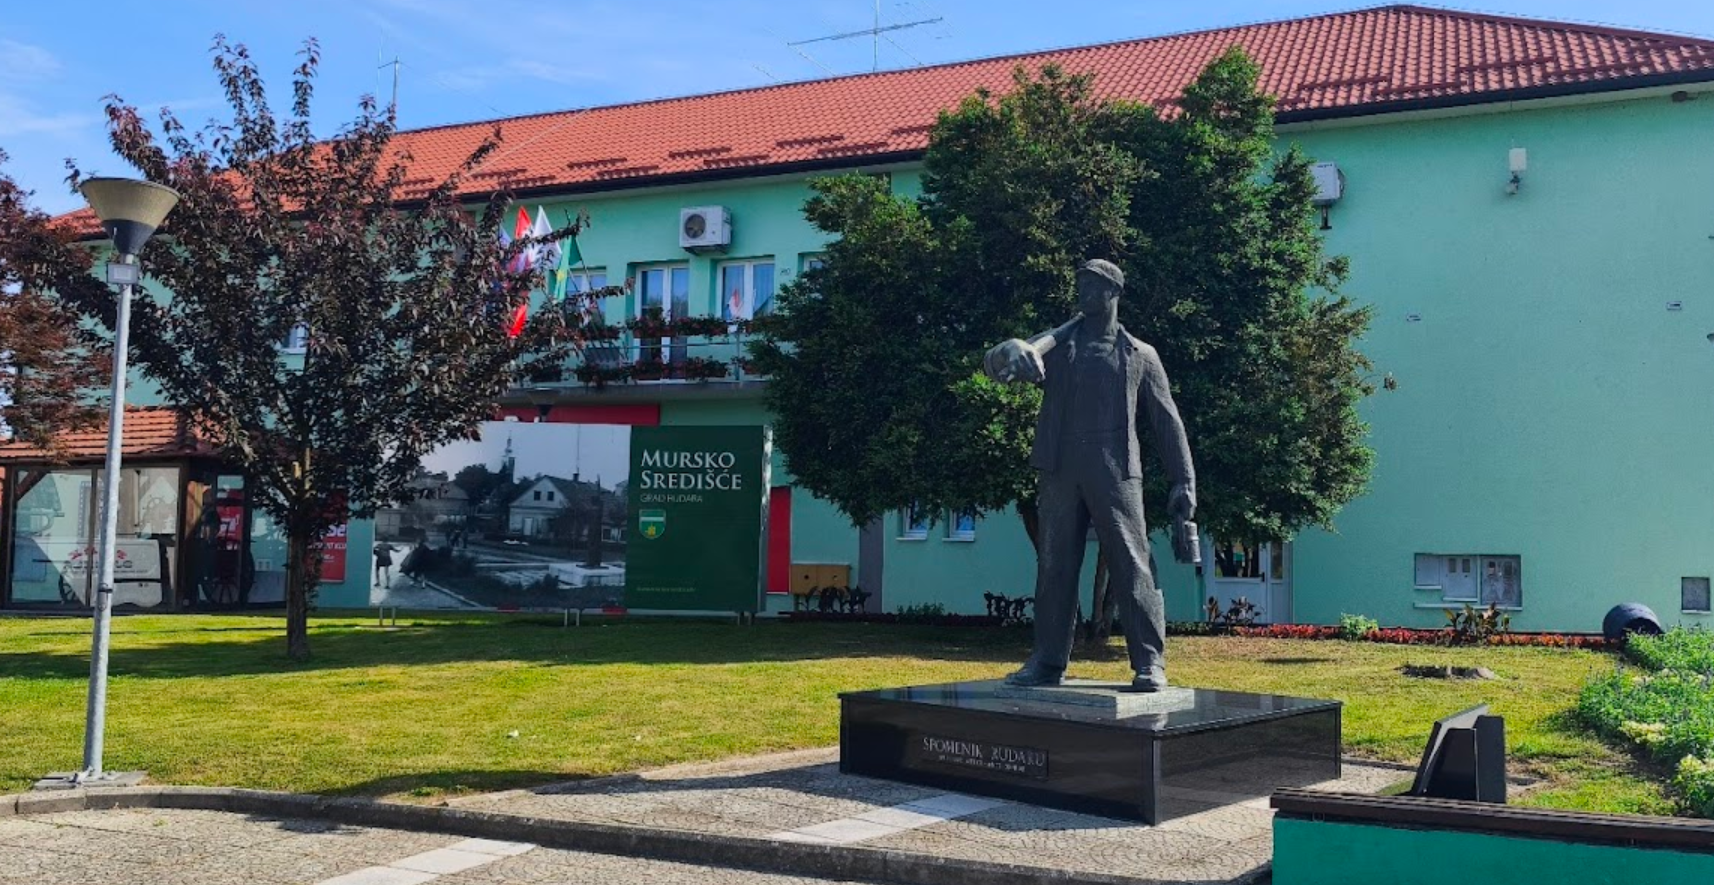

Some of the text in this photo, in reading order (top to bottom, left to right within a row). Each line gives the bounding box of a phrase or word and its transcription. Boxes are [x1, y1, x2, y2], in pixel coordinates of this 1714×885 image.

[640, 449, 736, 469] MURSKO
[640, 469, 742, 490] SREDIŠĆE
[640, 493, 667, 503] GRAD
[923, 737, 983, 758] SPOMENIK
